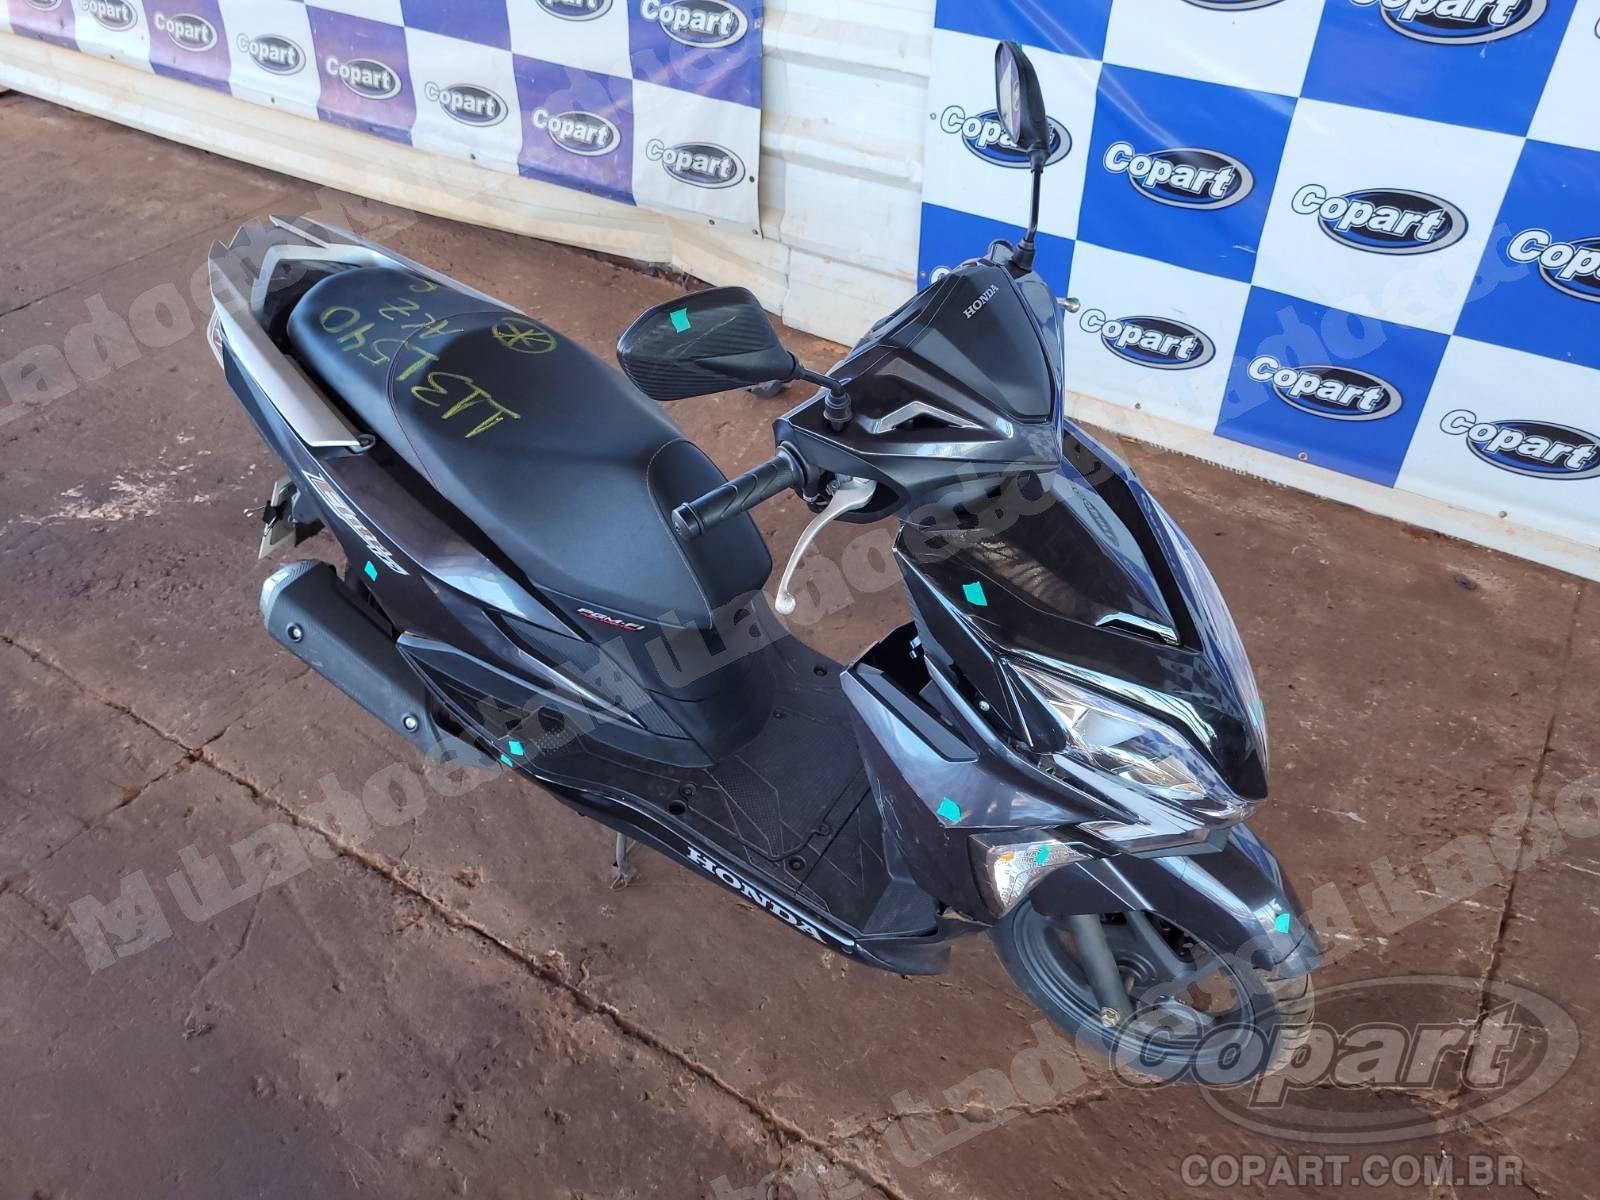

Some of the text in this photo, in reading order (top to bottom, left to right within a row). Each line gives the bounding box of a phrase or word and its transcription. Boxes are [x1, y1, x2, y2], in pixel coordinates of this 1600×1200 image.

[154, 12, 210, 43] Copart
[640, 0, 733, 37] Copart
[1352, 0, 1521, 26] part
[236, 33, 297, 66] Copart
[325, 58, 392, 93] Copart
[424, 82, 496, 117] Copart
[531, 108, 609, 149] Copart
[645, 139, 733, 179] Copart
[1103, 141, 1236, 199] Copart
[1291, 184, 1450, 243] Copart
[963, 284, 999, 319] HONDA
[1079, 309, 1200, 361] Copart
[1247, 355, 1383, 413] Copart
[1440, 409, 1597, 470] Copart
[687, 846, 827, 944] HONDA
